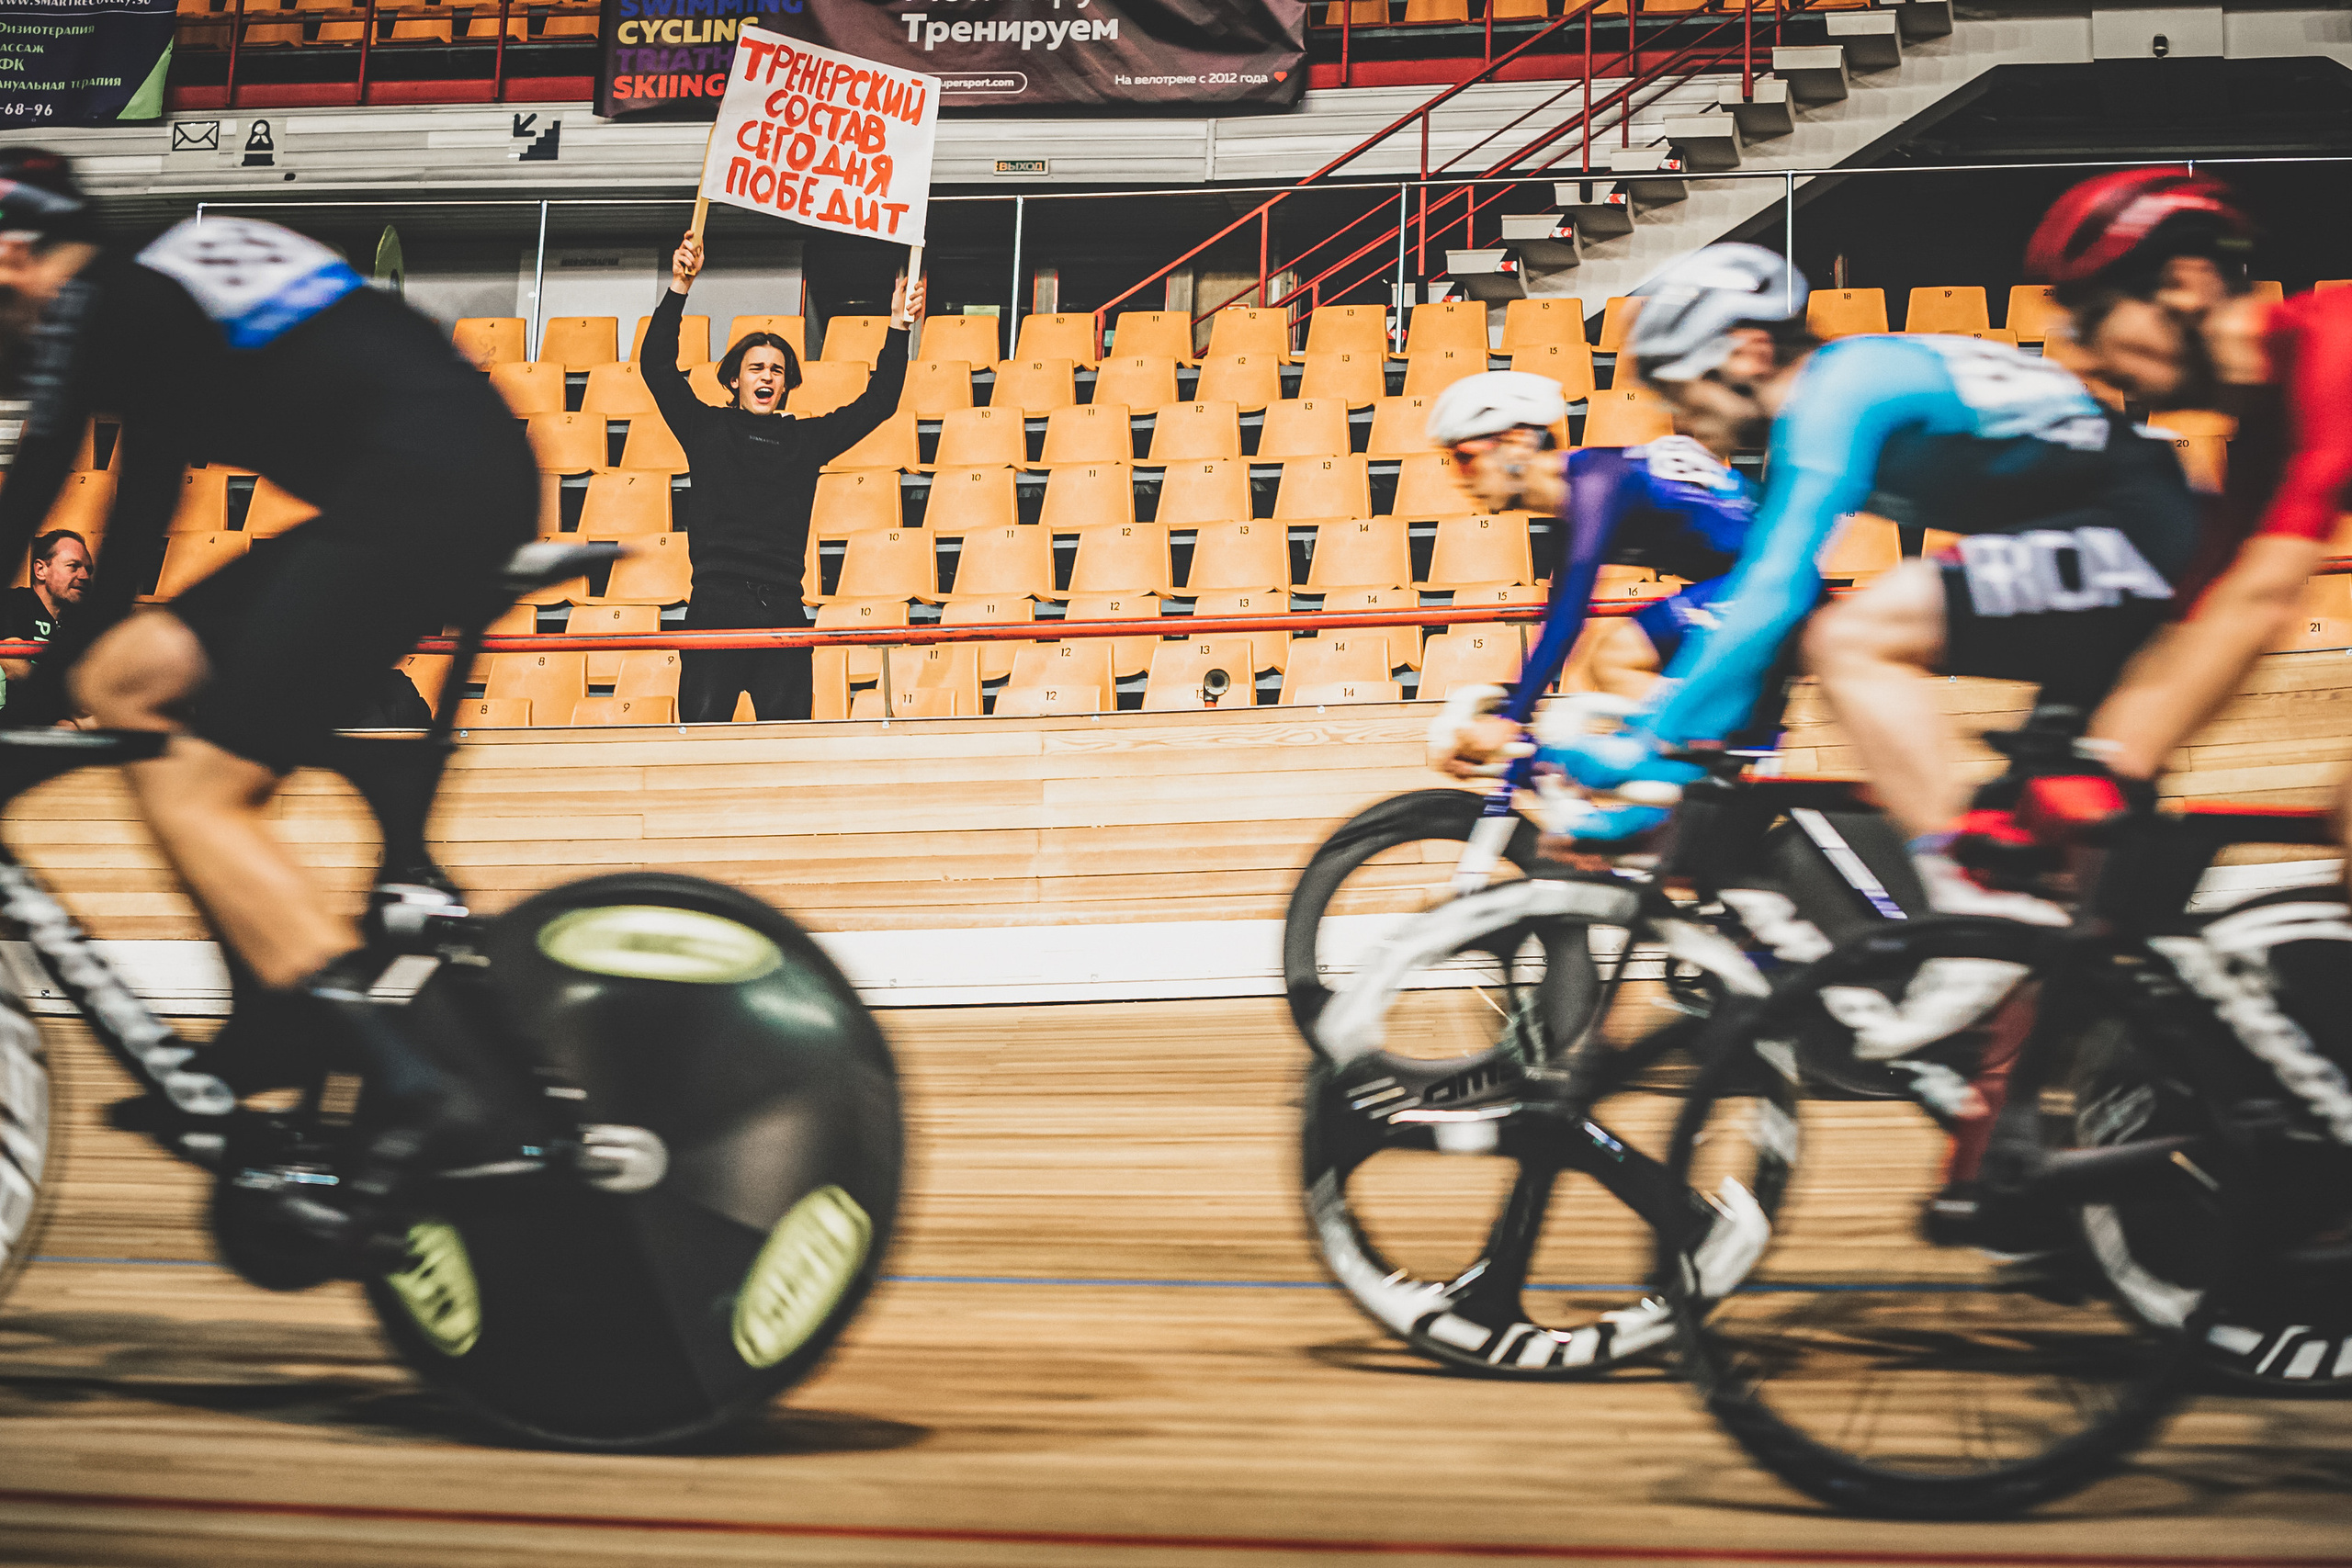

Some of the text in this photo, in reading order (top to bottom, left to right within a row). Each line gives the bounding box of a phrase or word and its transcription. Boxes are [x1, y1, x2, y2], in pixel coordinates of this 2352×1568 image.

[619, 0, 803, 17] SWIMMING
[901, 13, 1119, 51] Тренируем
[616, 46, 736, 73] TRIATH
[0, 58, 26, 72] ФК
[740, 36, 926, 127] ТРЕНЕРСКИЙ
[941, 78, 1014, 90] upersport.com
[1114, 73, 1269, 86] На велотреке с 2012 года
[613, 73, 726, 99] SKIING
[0, 103, 53, 117] -68-96
[765, 89, 887, 154] СОСТАВ
[737, 119, 894, 198] СЕГОДНЯ
[999, 162, 1043, 172] ВЫХОД
[725, 156, 910, 236] ПОБЕДИТ
[1843, 292, 1852, 300] 18
[2042, 288, 2054, 297] 20
[1346, 309, 1355, 317] 13
[1445, 305, 1454, 313] 14
[1549, 346, 1558, 355] 15
[1136, 359, 1144, 367] 11
[1238, 356, 1247, 365] 12
[1341, 354, 1351, 363] 13
[1627, 392, 1635, 400] 16
[1305, 402, 1313, 411] 13
[1413, 400, 1422, 408] 14
[1195, 405, 1204, 413] 12
[981, 411, 991, 419] 10
[2176, 439, 2189, 448] 20
[1322, 461, 1331, 470] 13
[1441, 457, 1450, 466] 14
[1089, 469, 1096, 478] 11
[1204, 465, 1214, 474] 12
[971, 473, 982, 481] 10
[1360, 524, 1369, 533] 14
[1480, 520, 1489, 529] 15
[1006, 530, 1014, 538] 11
[1122, 527, 1132, 536] 12
[1239, 525, 1250, 535] 13
[889, 533, 899, 541] 10
[1498, 592, 1508, 601] 15
[1628, 587, 1638, 597] 16
[1239, 598, 1250, 608] 13
[1367, 595, 1377, 604] 14
[987, 604, 995, 614] 11
[1110, 602, 1121, 611] 12
[861, 607, 872, 616] 10
[2310, 622, 2321, 632] 21
[1335, 642, 1345, 652] 14
[1473, 638, 1484, 649] 15
[930, 649, 939, 660] 11
[1061, 647, 1071, 657] 12
[1200, 645, 1210, 655] 13
[1046, 691, 1057, 701] 12
[1344, 687, 1354, 697] 14
[903, 694, 912, 704] 11
